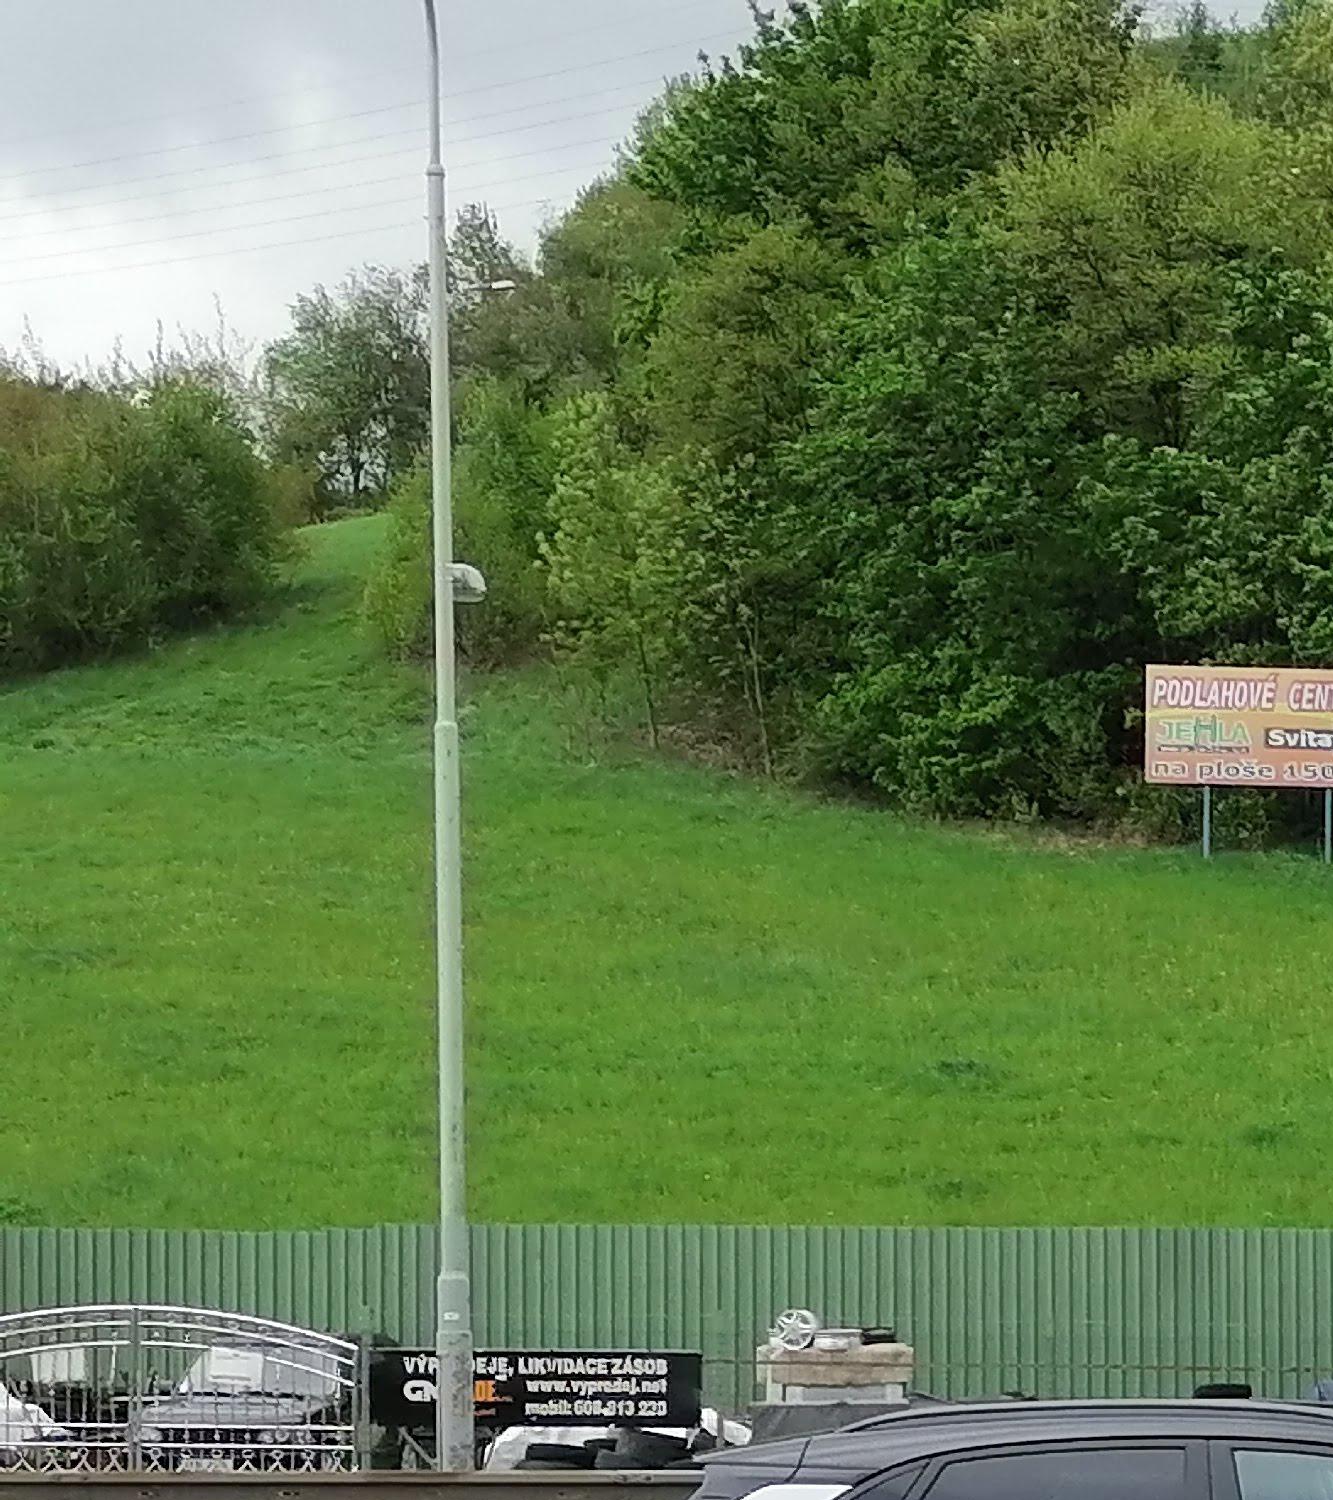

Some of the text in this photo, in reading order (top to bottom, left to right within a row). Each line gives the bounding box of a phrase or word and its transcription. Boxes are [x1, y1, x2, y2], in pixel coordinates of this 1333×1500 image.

[1152, 674, 1278, 711] PODLAHOVÉ
[1157, 714, 1252, 745] JEHLA
[1152, 762, 1189, 780] na
[1199, 760, 1274, 782] ploše
[518, 1356, 608, 1377] LIKVIDACE
[611, 1355, 668, 1377] ZÁSOB
